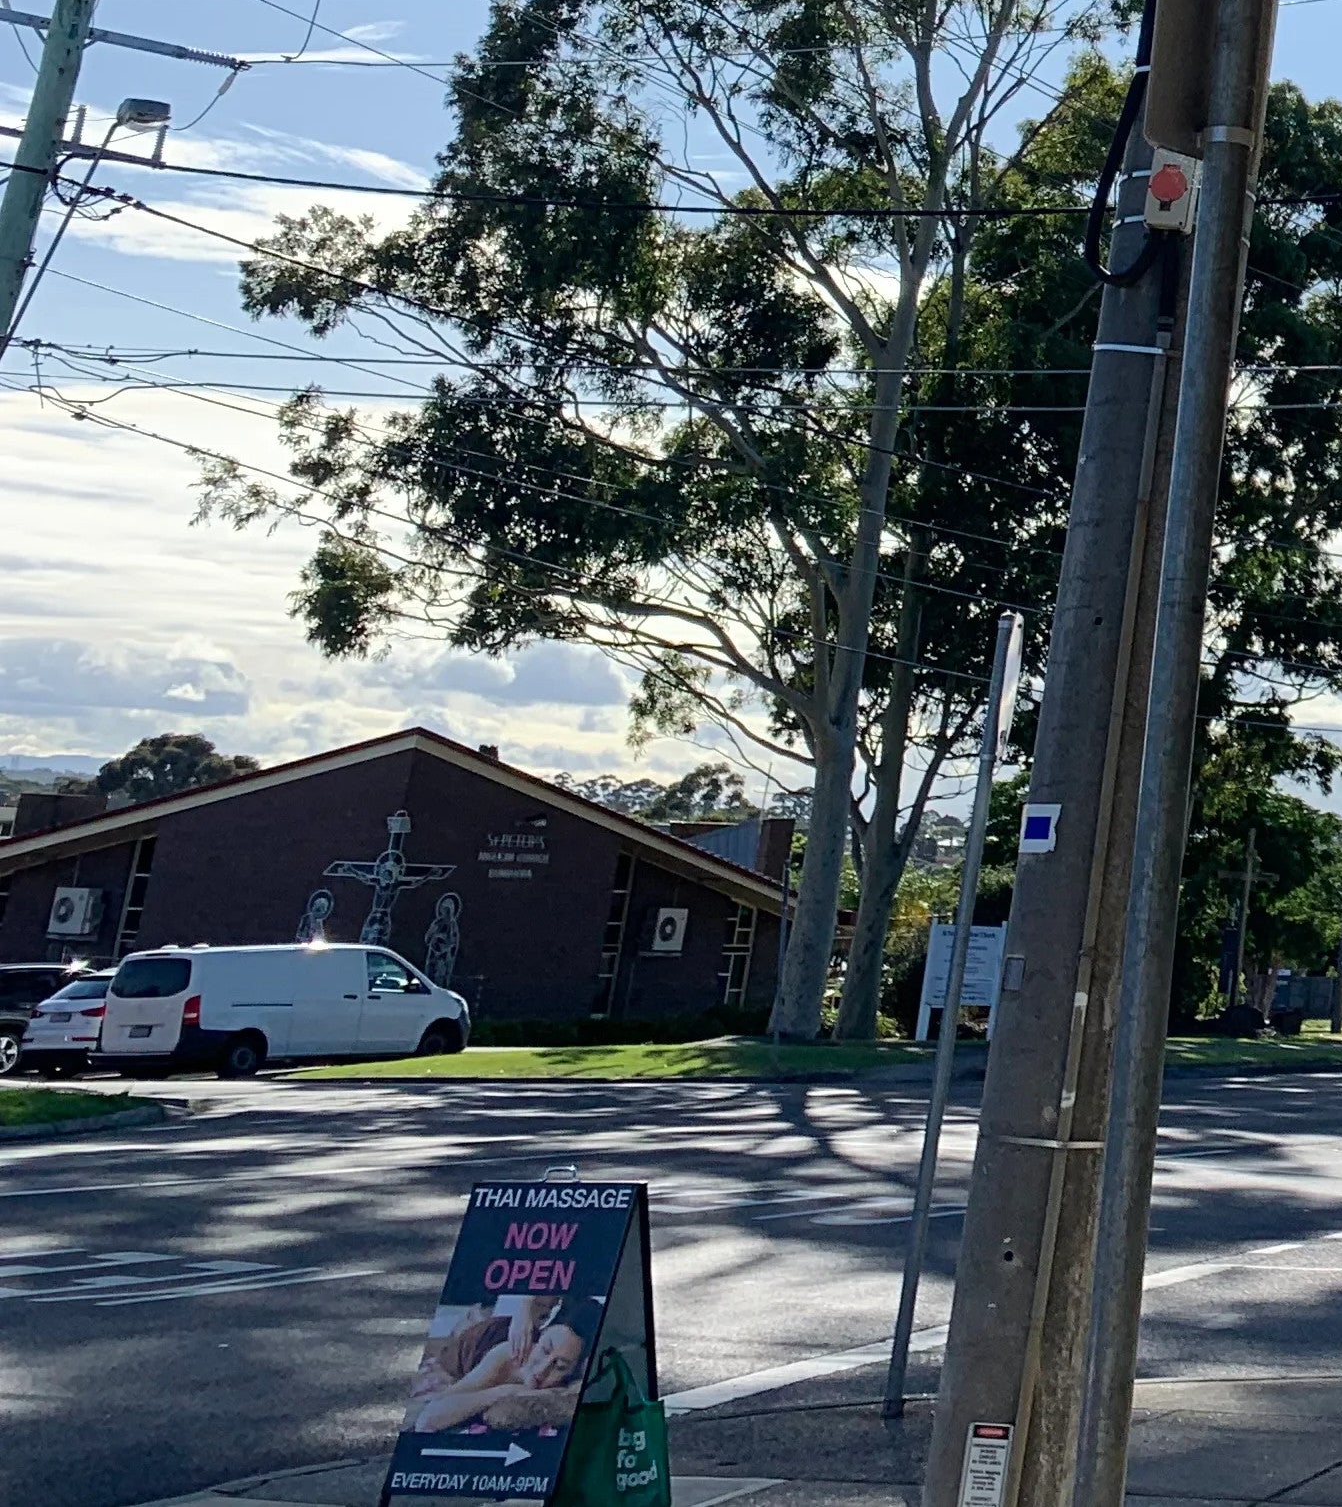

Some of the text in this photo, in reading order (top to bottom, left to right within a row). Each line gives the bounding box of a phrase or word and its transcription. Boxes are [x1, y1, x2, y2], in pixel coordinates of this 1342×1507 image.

[473, 1188, 631, 1209] THAI MASSAGE
[503, 1223, 579, 1250] NOW
[484, 1259, 576, 1290] OPEN
[391, 1472, 549, 1493] EVERYDAY 10AM-9PM
[616, 1460, 658, 1492] good
